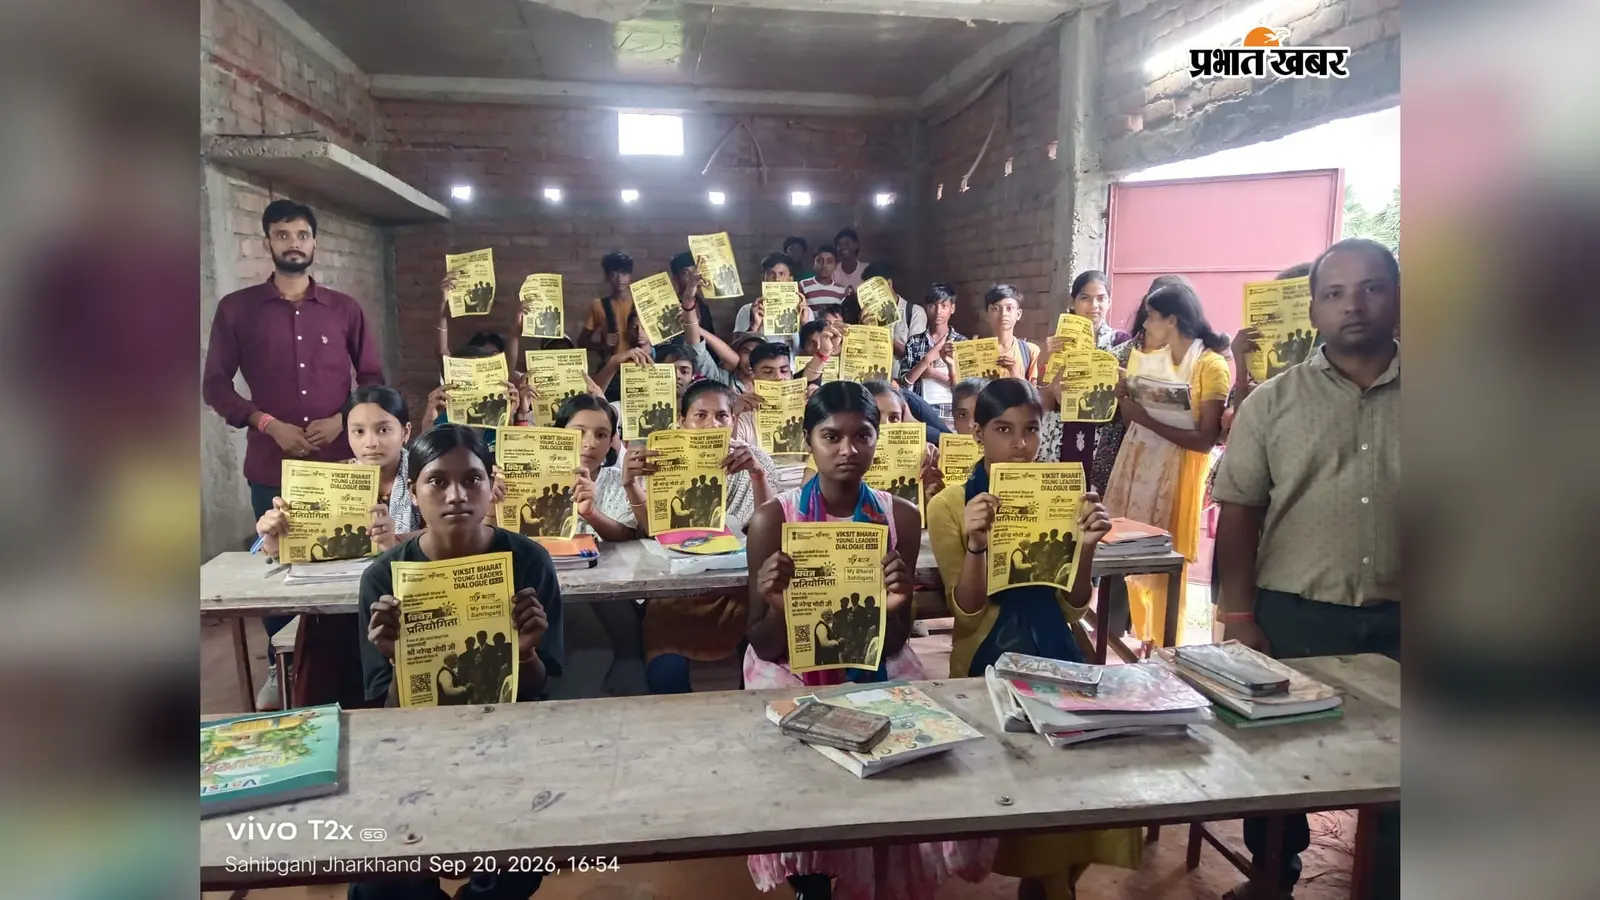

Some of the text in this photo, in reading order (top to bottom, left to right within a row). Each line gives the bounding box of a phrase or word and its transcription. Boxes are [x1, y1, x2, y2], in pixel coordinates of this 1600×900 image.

[452, 563, 502, 577] VIKSIT BHARAT
[453, 570, 503, 582] YOUNG LEADERS
[453, 579, 488, 590] DIALOGUE
[791, 577, 836, 589] प्रतियोगिता
[406, 617, 458, 635] प्रतियोगिता
